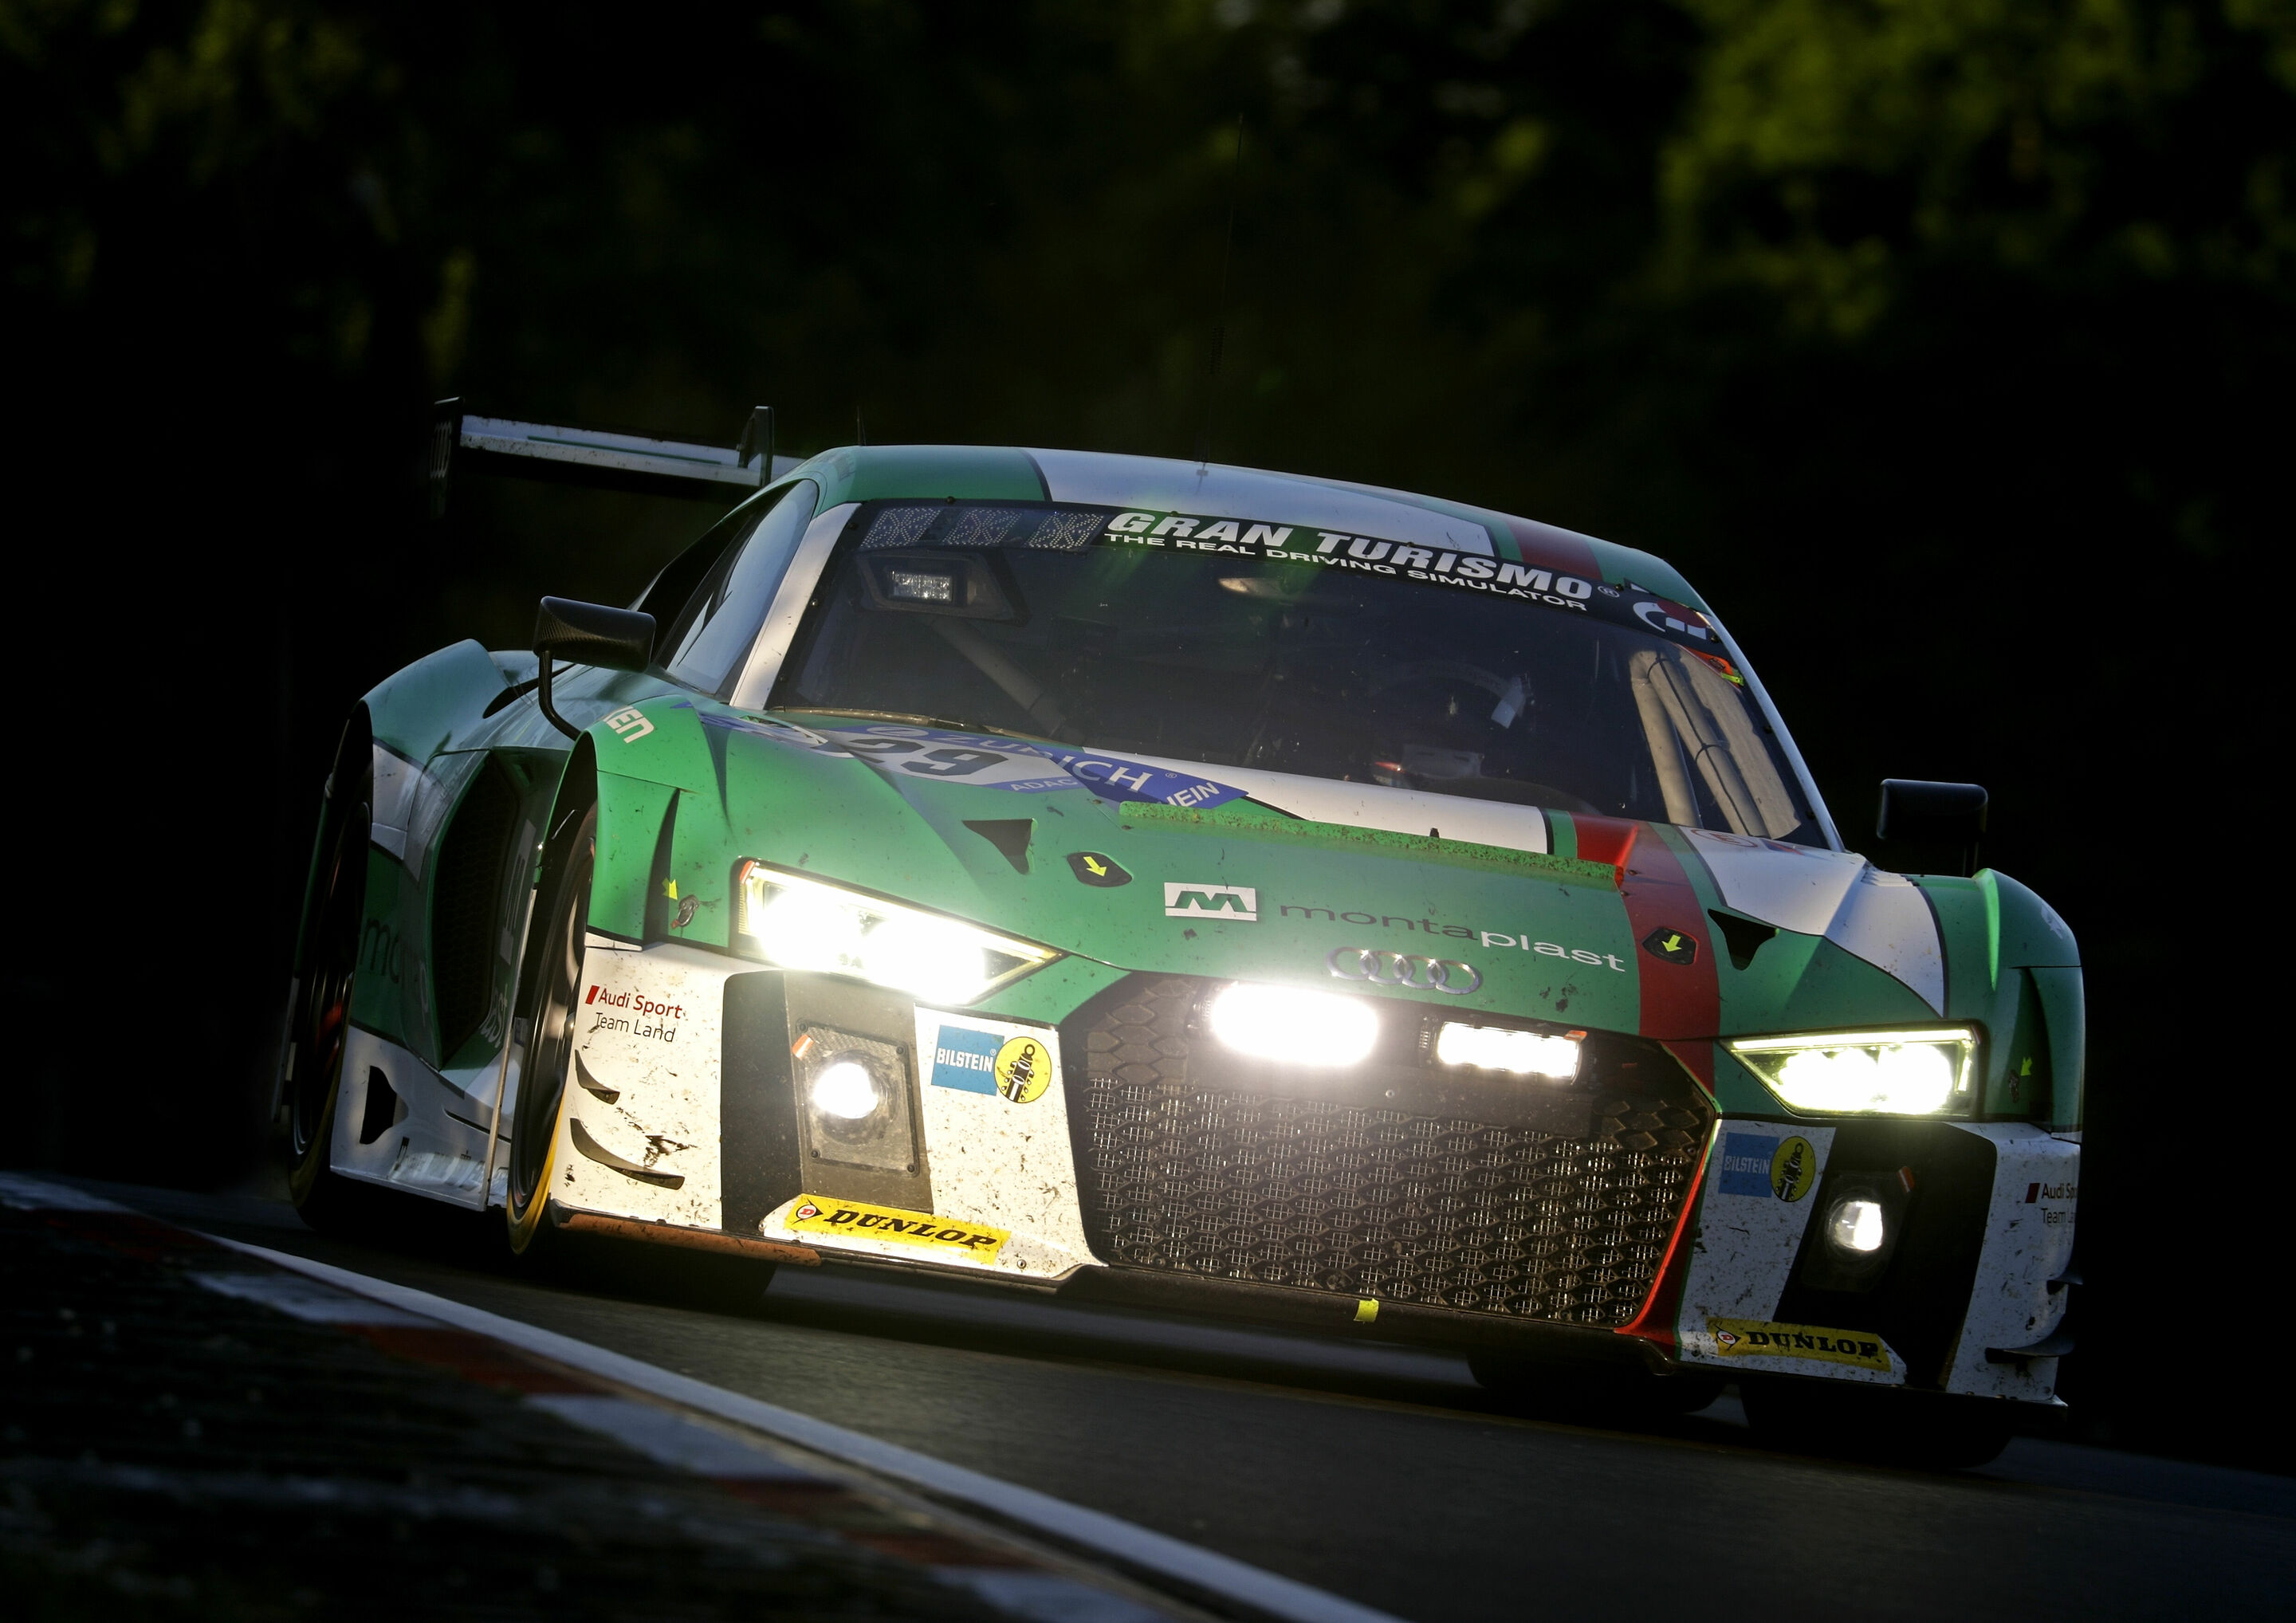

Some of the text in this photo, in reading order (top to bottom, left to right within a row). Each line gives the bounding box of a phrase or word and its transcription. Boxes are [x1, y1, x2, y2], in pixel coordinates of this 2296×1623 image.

[1107, 512, 1592, 599] GRAN TURISMO
[1104, 532, 1587, 611] THE REAL DRIVING SIMULATOR
[1010, 778, 1079, 792] ADAC
[1280, 904, 1626, 972] montaplast
[598, 988, 683, 1019] Audi Sport
[596, 1012, 676, 1043] Team Land
[936, 1047, 994, 1073] BILSTEIN
[1723, 1155, 1771, 1175] BILSTEIN
[2041, 1183, 2064, 1199] Audi
[823, 1209, 997, 1248] DUNLOP
[2041, 1208, 2066, 1224] Team
[1746, 1331, 1878, 1358] DUNLOP
